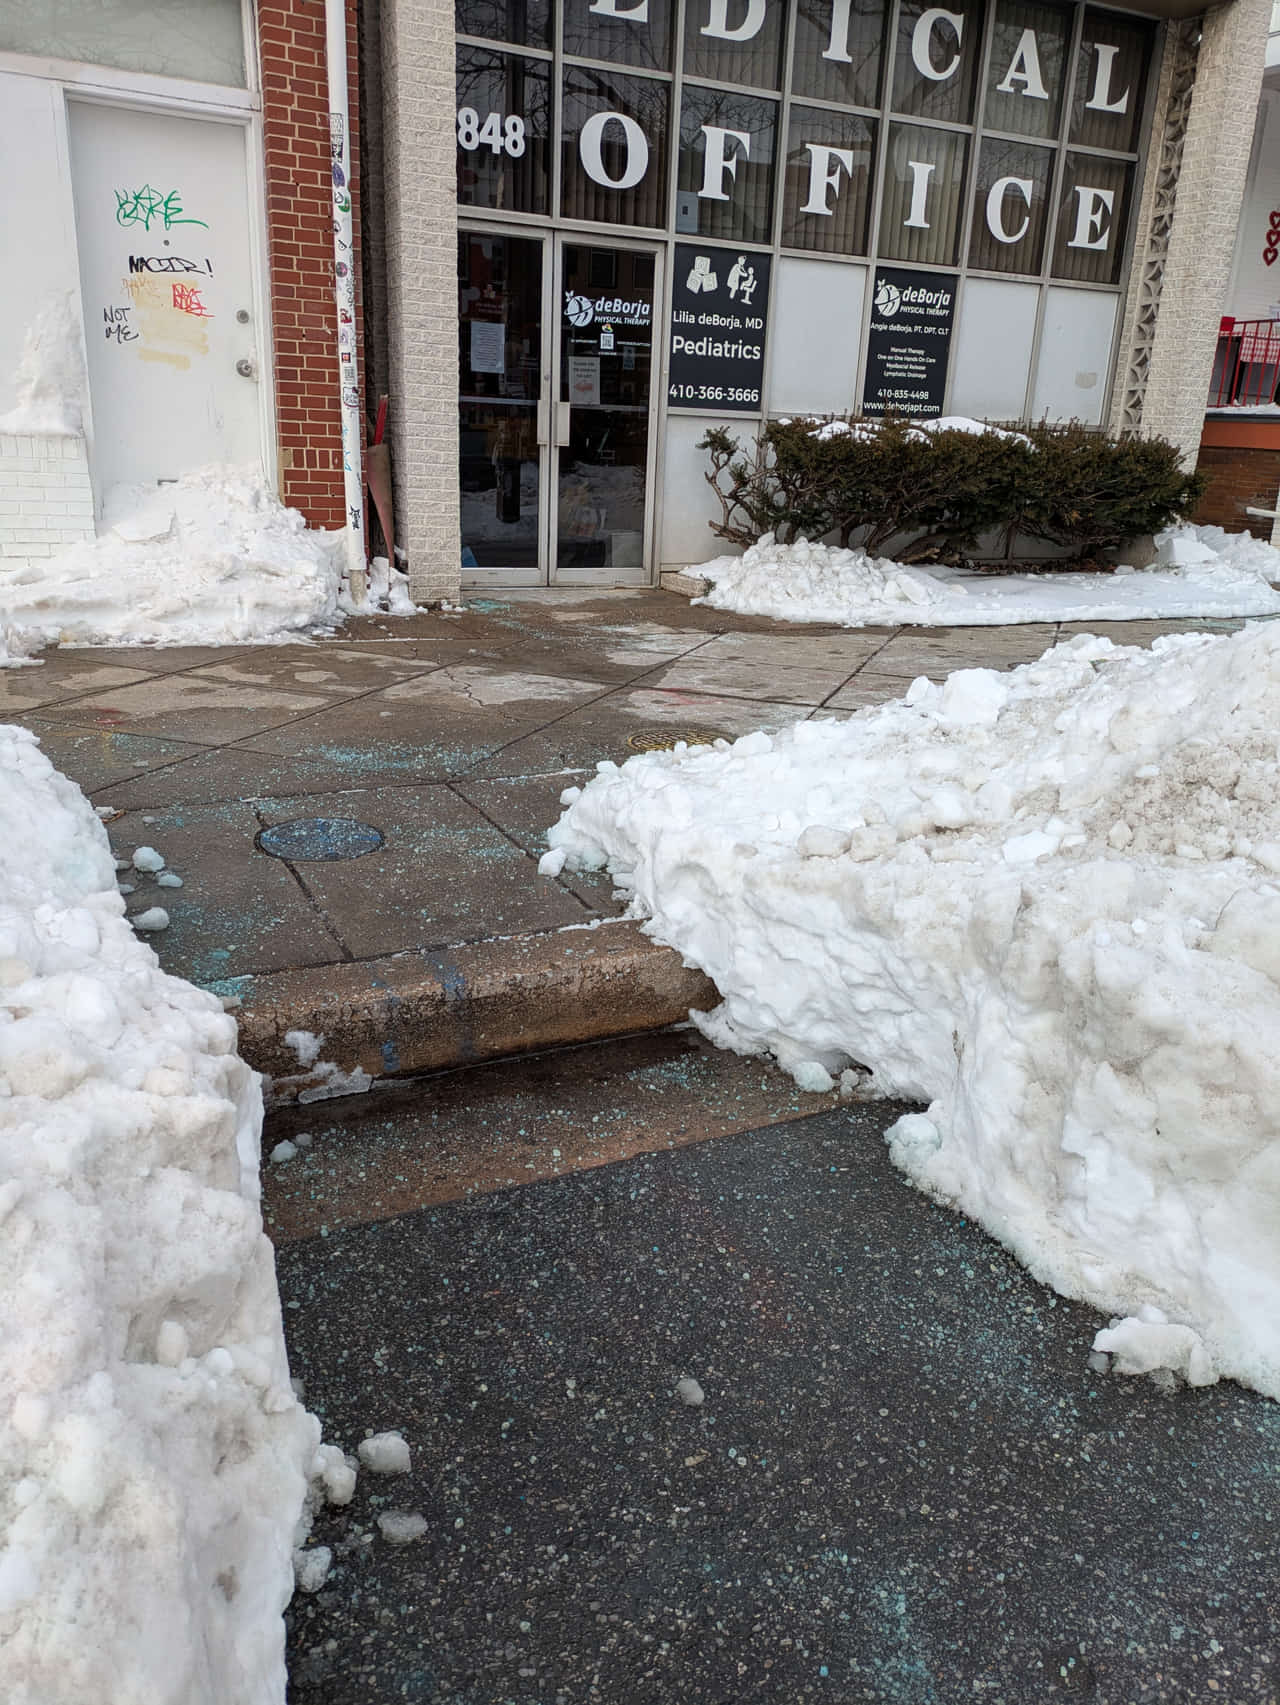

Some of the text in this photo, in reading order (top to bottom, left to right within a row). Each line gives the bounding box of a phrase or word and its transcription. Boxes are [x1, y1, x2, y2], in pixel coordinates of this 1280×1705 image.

[589, 0, 1130, 115] DICAL
[457, 106, 526, 158] 848
[579, 111, 1116, 251] OFFICE
[595, 296, 651, 318] deBorja
[902, 285, 952, 309] deBorja
[103, 304, 132, 323] NOT
[594, 315, 651, 326] PHYSICAL THERAPY
[672, 310, 696, 325] Lilia
[745, 317, 764, 330] MD
[899, 304, 950, 317] PHYSICAL THERAPY
[870, 322, 888, 331] Angie
[938, 327, 950, 336] CLT
[672, 335, 762, 361] Pediatrics
[669, 384, 759, 403] 410-366-3666
[877, 388, 929, 400] 410-835-4498
